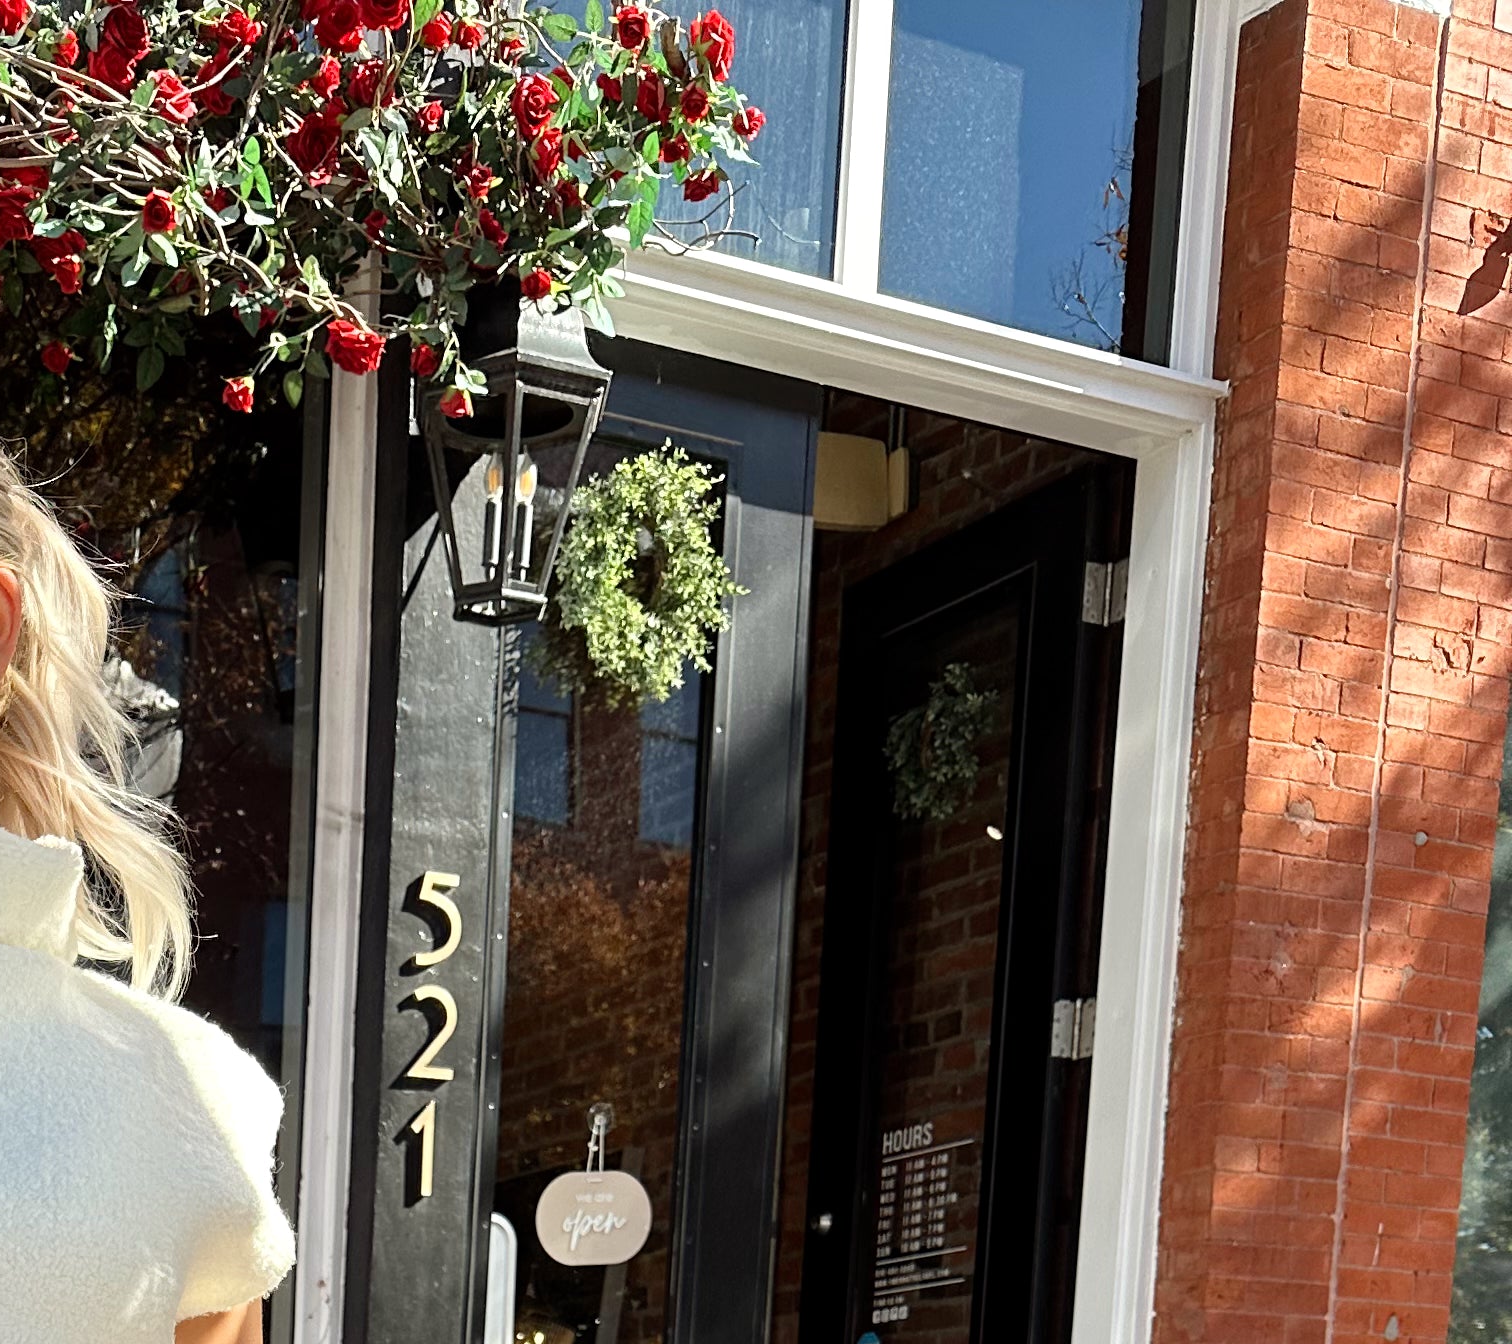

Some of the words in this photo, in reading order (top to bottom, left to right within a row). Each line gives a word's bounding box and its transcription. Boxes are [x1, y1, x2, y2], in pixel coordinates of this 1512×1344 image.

[407, 871, 462, 1198] 521
[882, 1122, 933, 1154] HOURS
[562, 1209, 627, 1251] open
